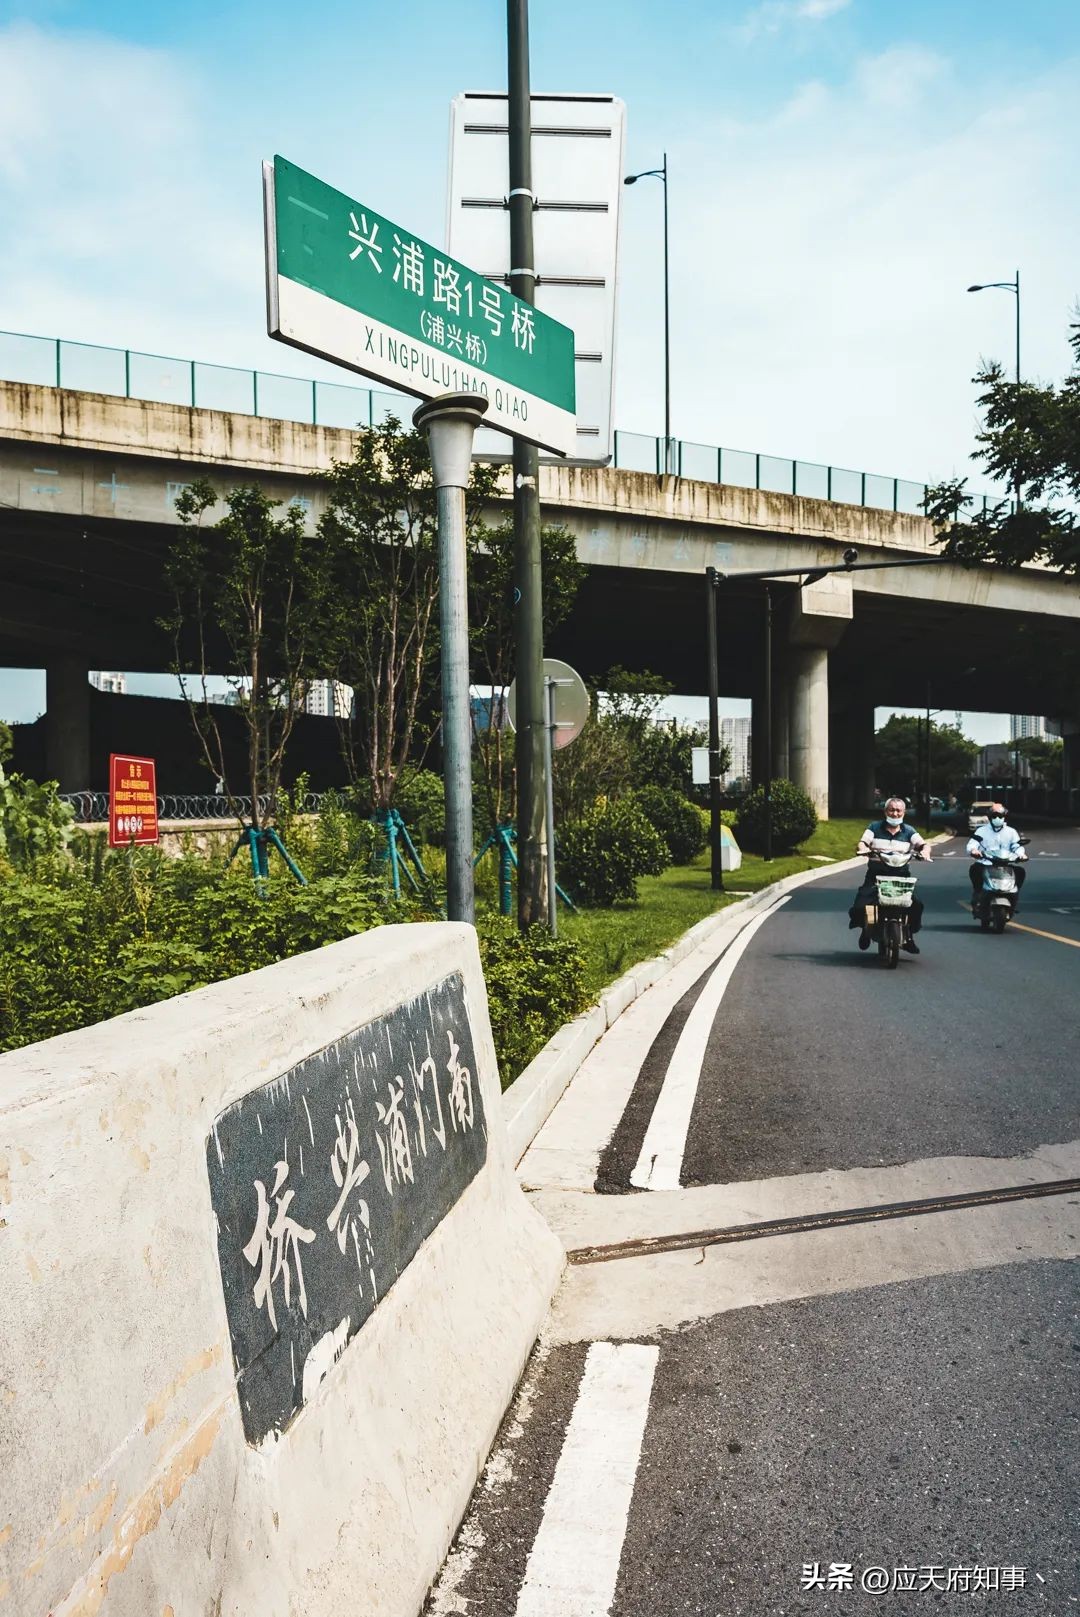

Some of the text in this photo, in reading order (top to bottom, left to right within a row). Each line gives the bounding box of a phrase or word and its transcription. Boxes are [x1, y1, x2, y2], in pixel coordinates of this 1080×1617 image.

[348, 212, 537, 354] 兴浦路1号桥
[364, 326, 529, 421] XINGPULU1HAO QIAO
[420, 309, 487, 365] (浦兴桥)
